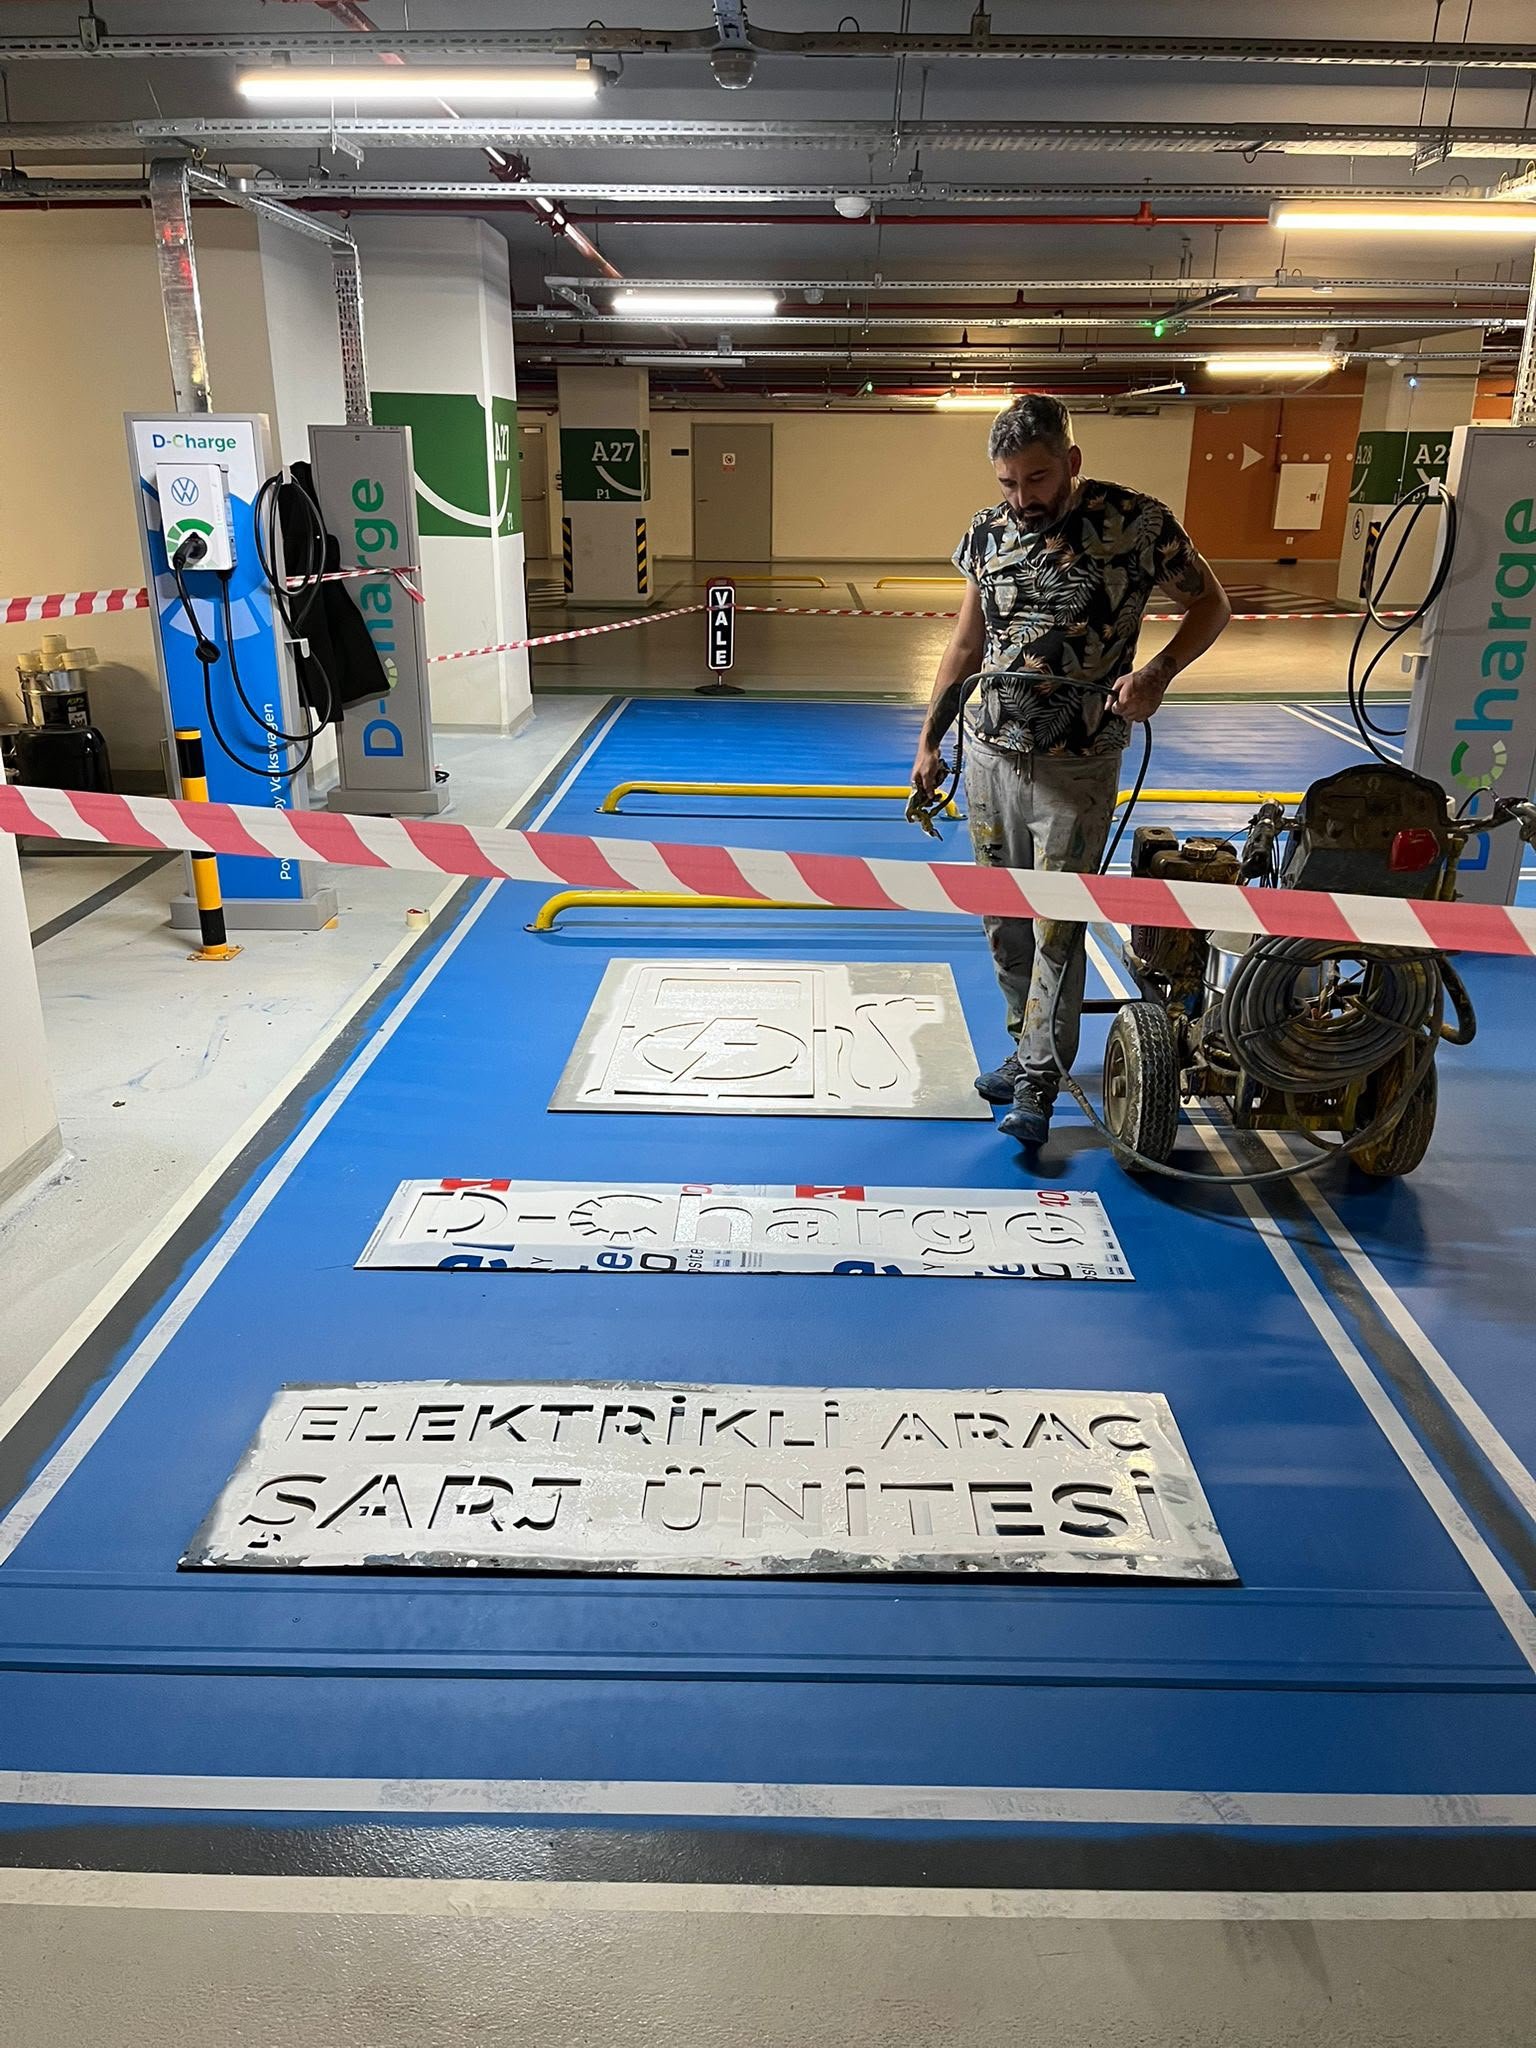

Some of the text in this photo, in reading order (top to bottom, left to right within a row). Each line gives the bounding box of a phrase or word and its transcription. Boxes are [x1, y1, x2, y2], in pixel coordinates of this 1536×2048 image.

[152, 434, 237, 452] D-Charge
[494, 422, 509, 461] A27
[591, 441, 635, 462] A27
[1355, 445, 1373, 465] A28
[1413, 444, 1451, 464] A2
[596, 488, 611, 499] P1
[714, 591, 729, 665] VALE
[400, 1192, 1087, 1256] D-Charge
[238, 1474, 582, 1549] ŞARJ
